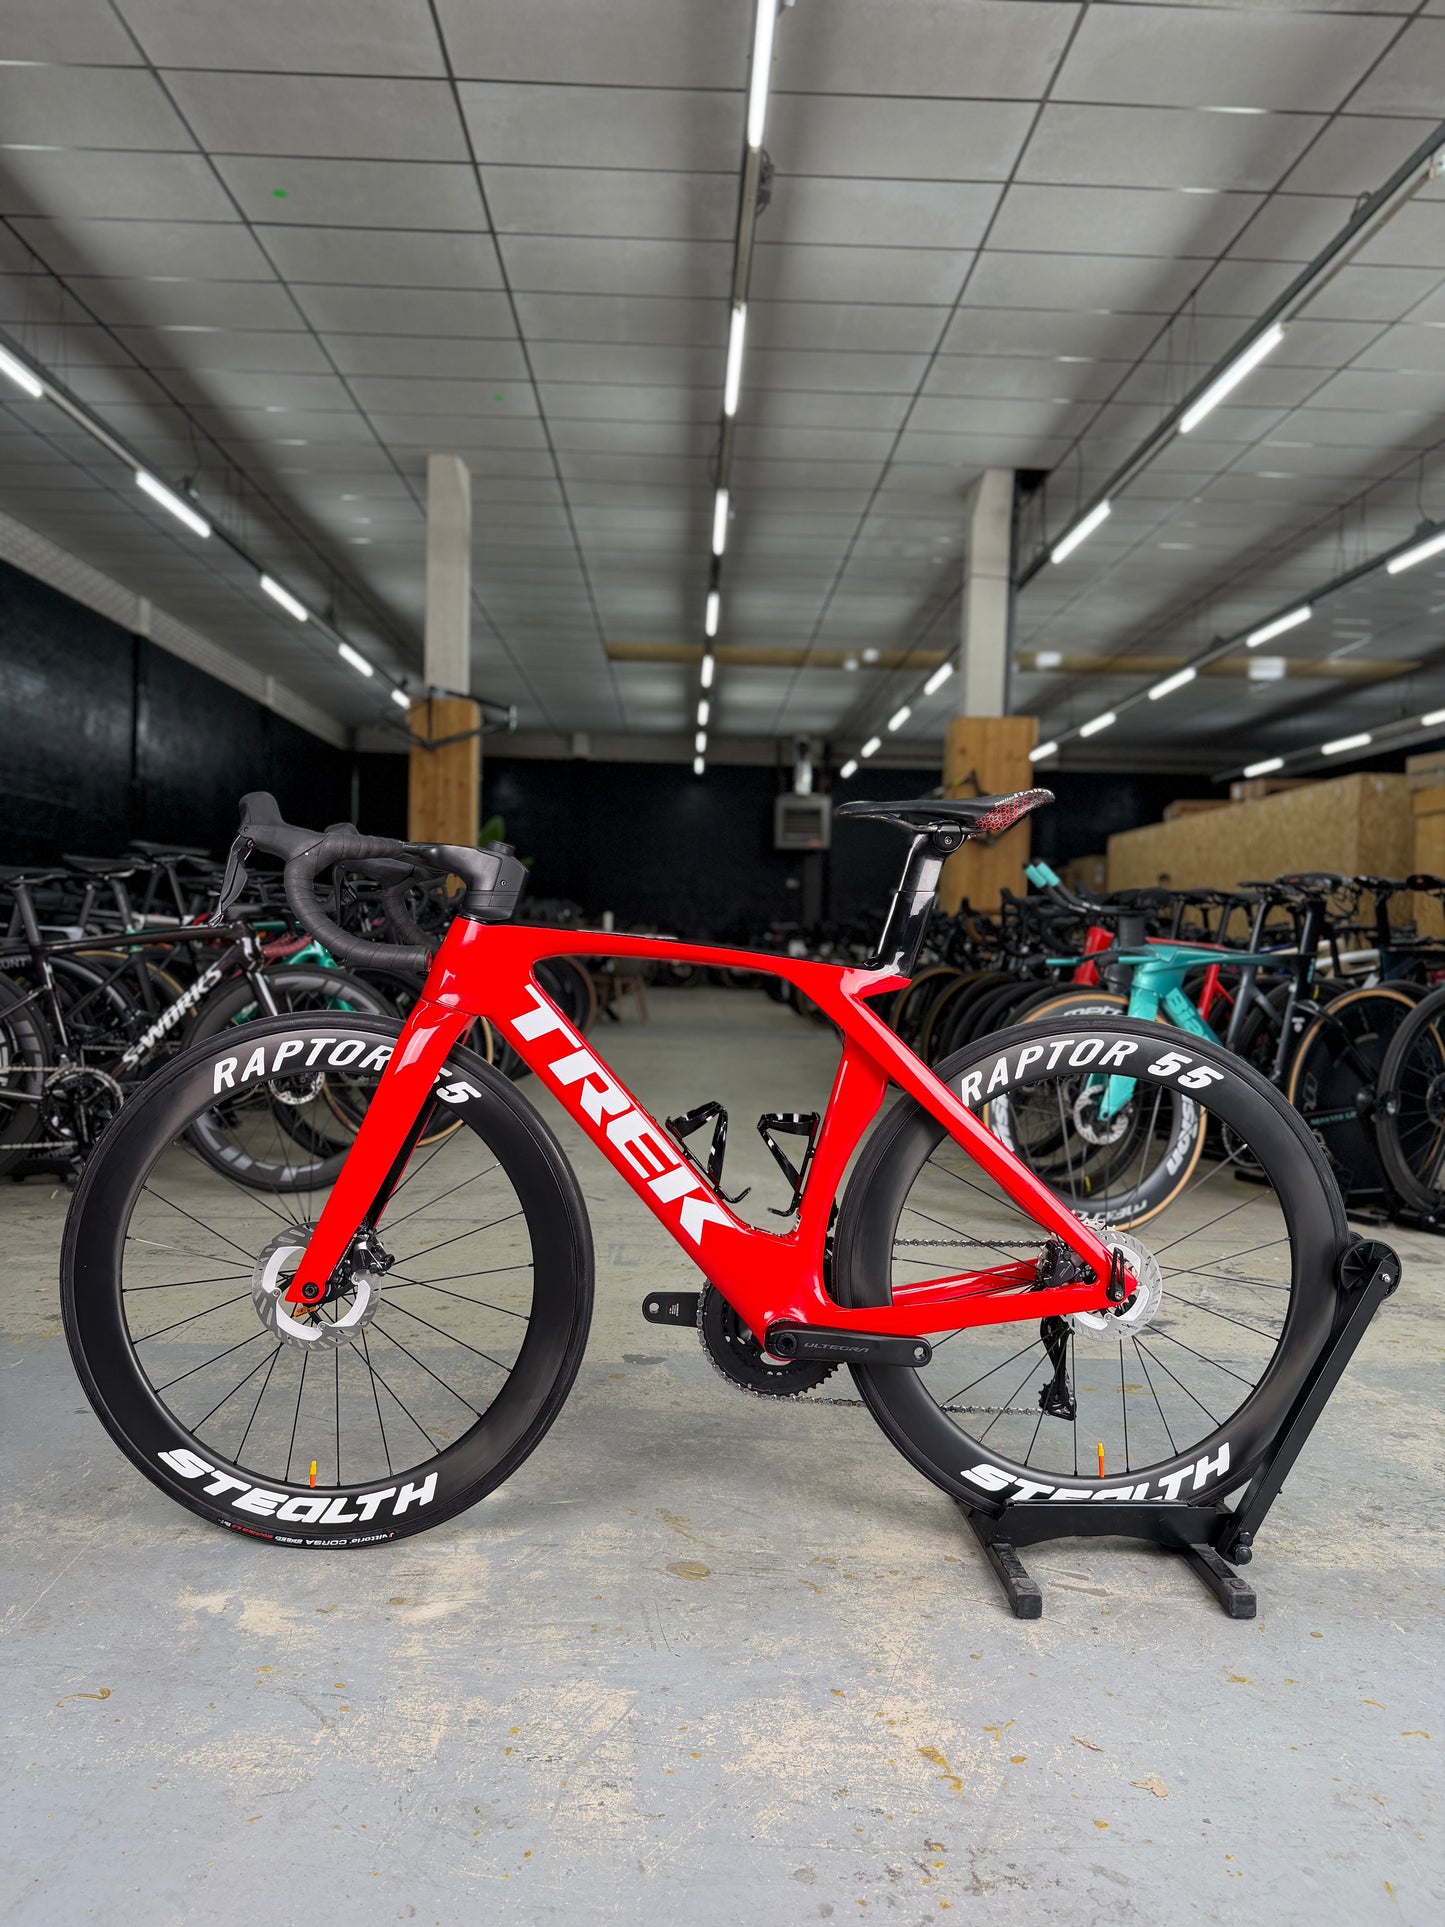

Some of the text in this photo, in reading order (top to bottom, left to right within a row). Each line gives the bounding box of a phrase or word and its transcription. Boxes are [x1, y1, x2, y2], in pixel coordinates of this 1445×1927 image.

[122, 961, 222, 1071] S-WORKS
[213, 1038, 395, 1095] RAPTOR
[961, 1038, 1225, 1107] RAPTOR 55
[511, 984, 735, 1245] TREK
[804, 1341, 870, 1354] ULTEGRA
[157, 1448, 438, 1524] STEALTH
